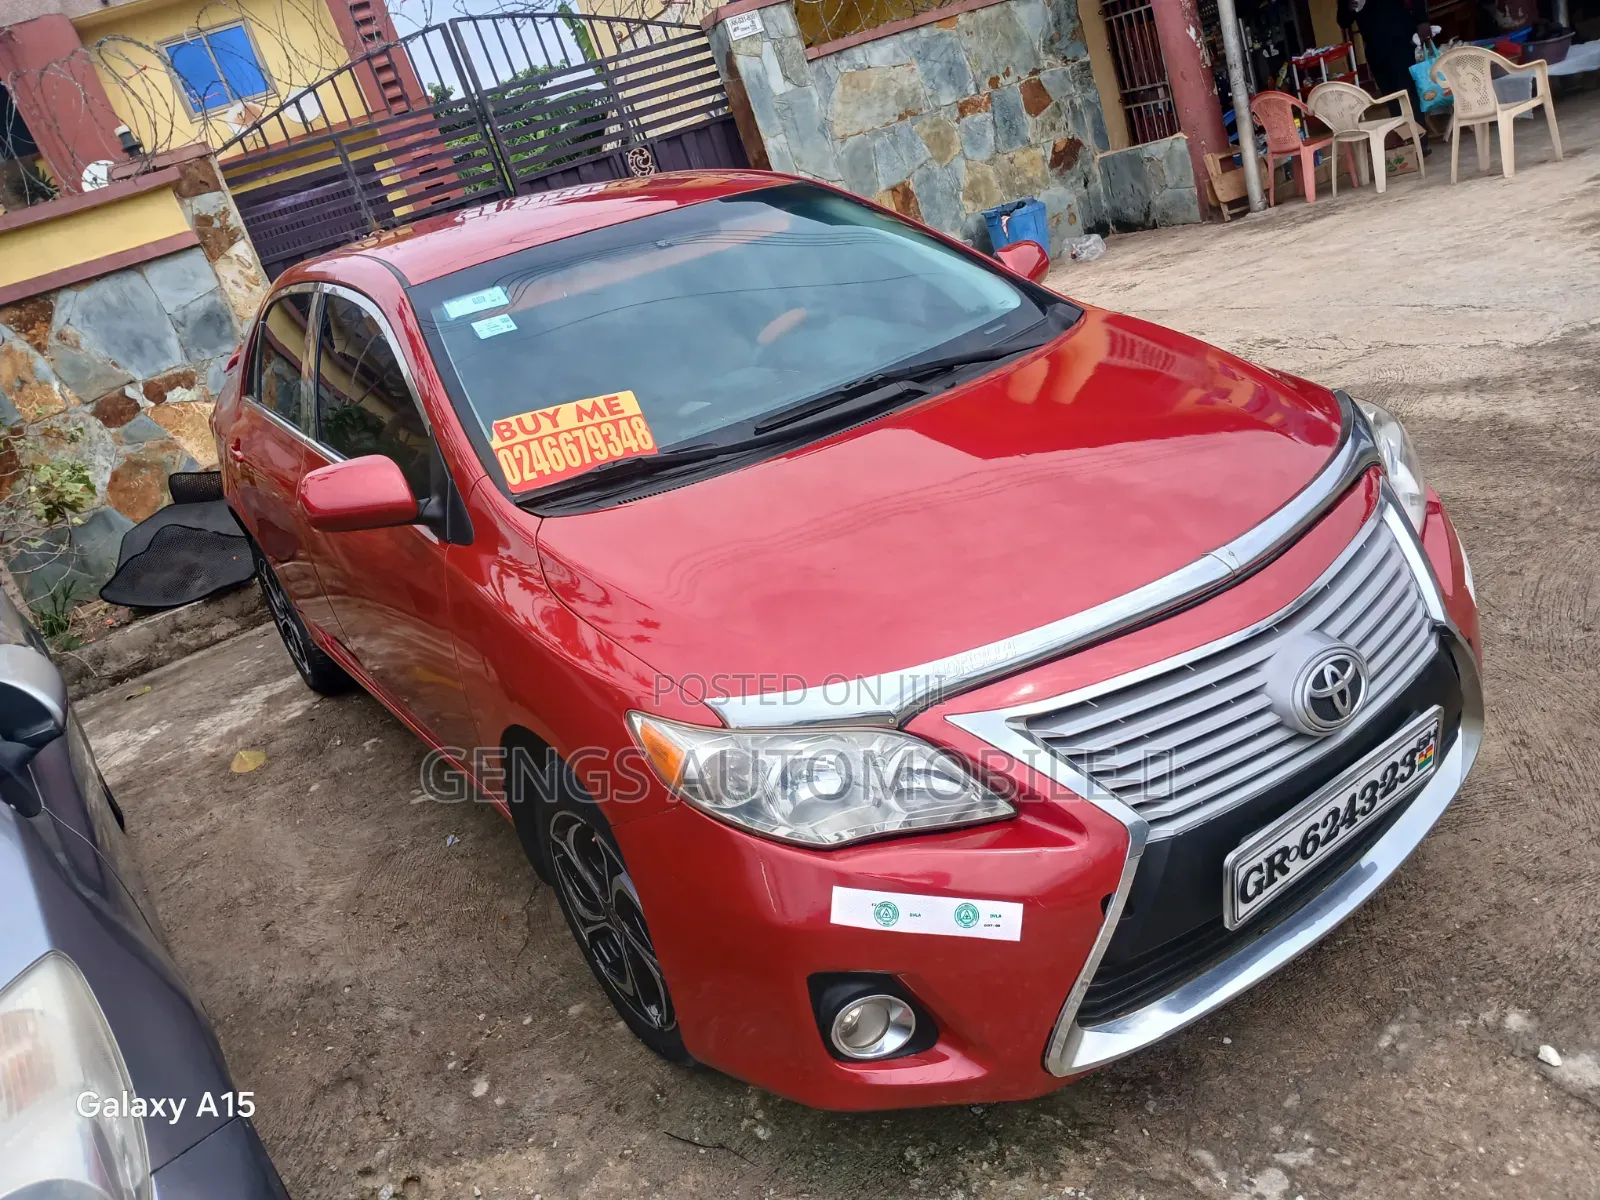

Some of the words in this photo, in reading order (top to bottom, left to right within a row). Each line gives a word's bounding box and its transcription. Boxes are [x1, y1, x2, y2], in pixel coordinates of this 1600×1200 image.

[493, 407, 562, 442] BUY
[575, 396, 625, 423] ME
[497, 416, 654, 486] 0246679348
[1416, 728, 1438, 750] GH
[1240, 845, 1291, 904] GR
